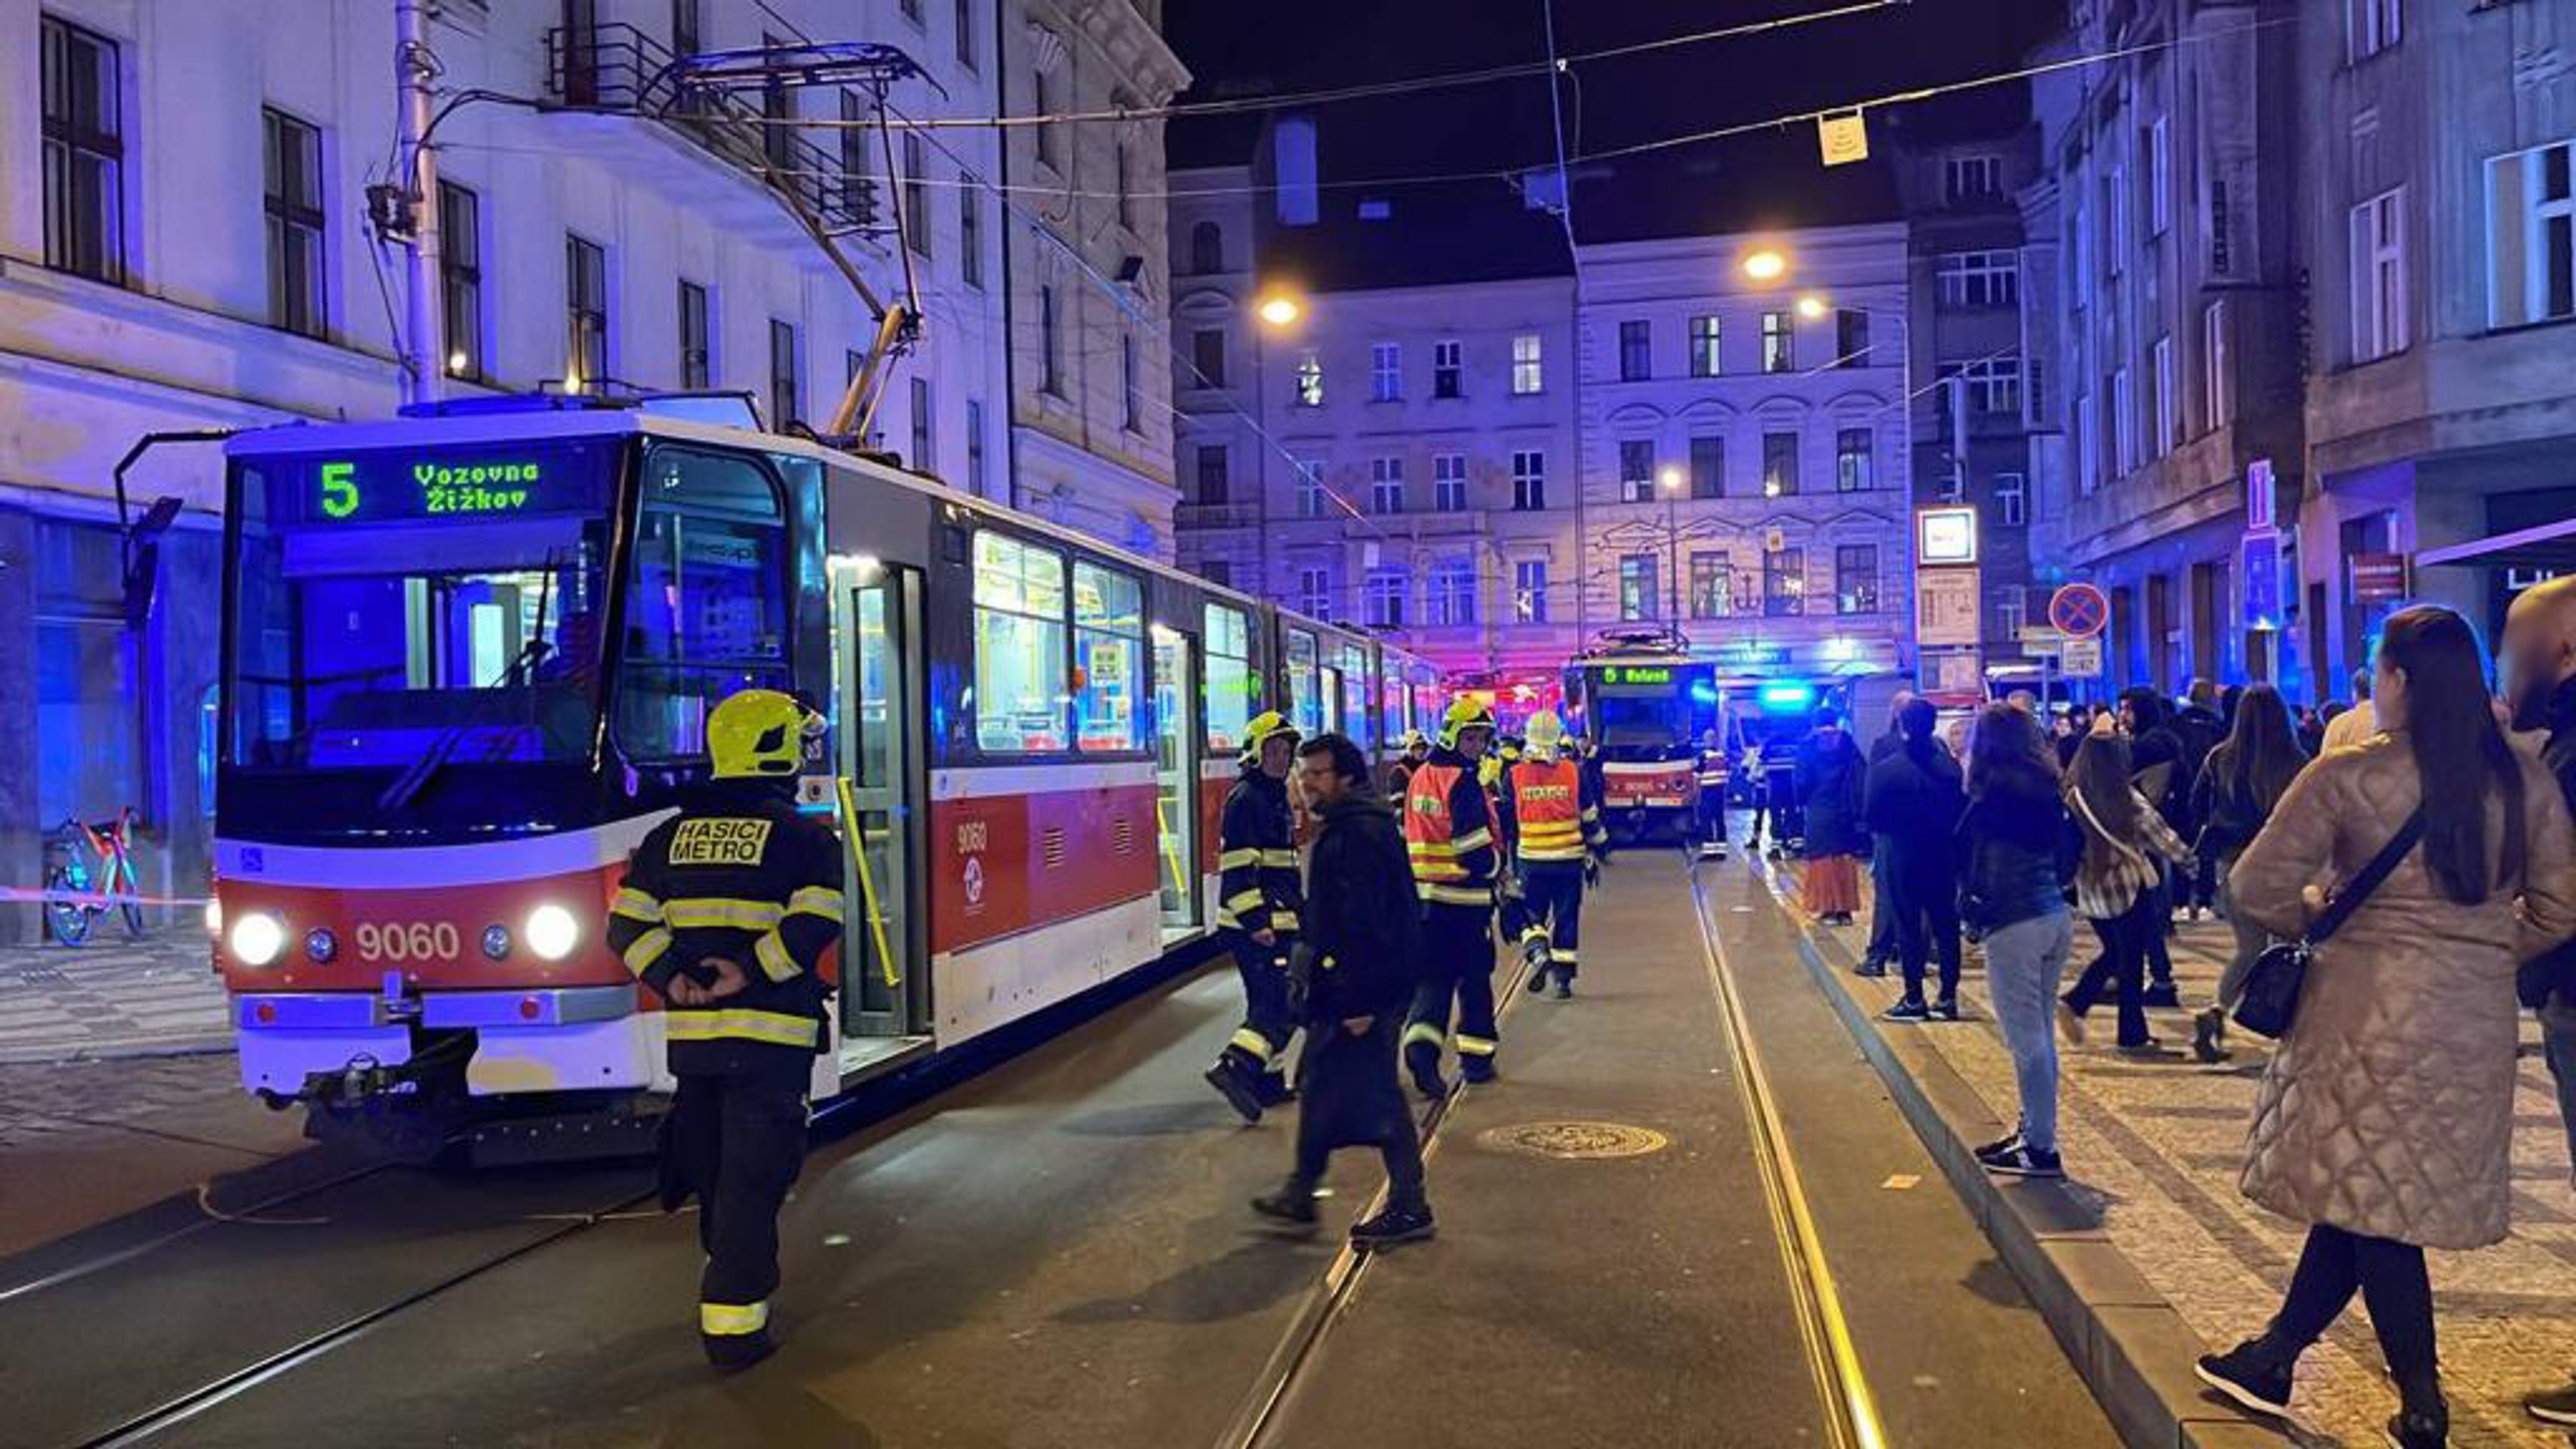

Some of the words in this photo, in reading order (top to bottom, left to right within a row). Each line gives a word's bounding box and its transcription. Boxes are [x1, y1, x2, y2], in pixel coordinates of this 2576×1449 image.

[322, 463, 359, 517] 5
[414, 463, 538, 486] Vozovna
[427, 486, 526, 512] Žižkov
[673, 840, 756, 860] METRO
[356, 922, 460, 961] 9060
